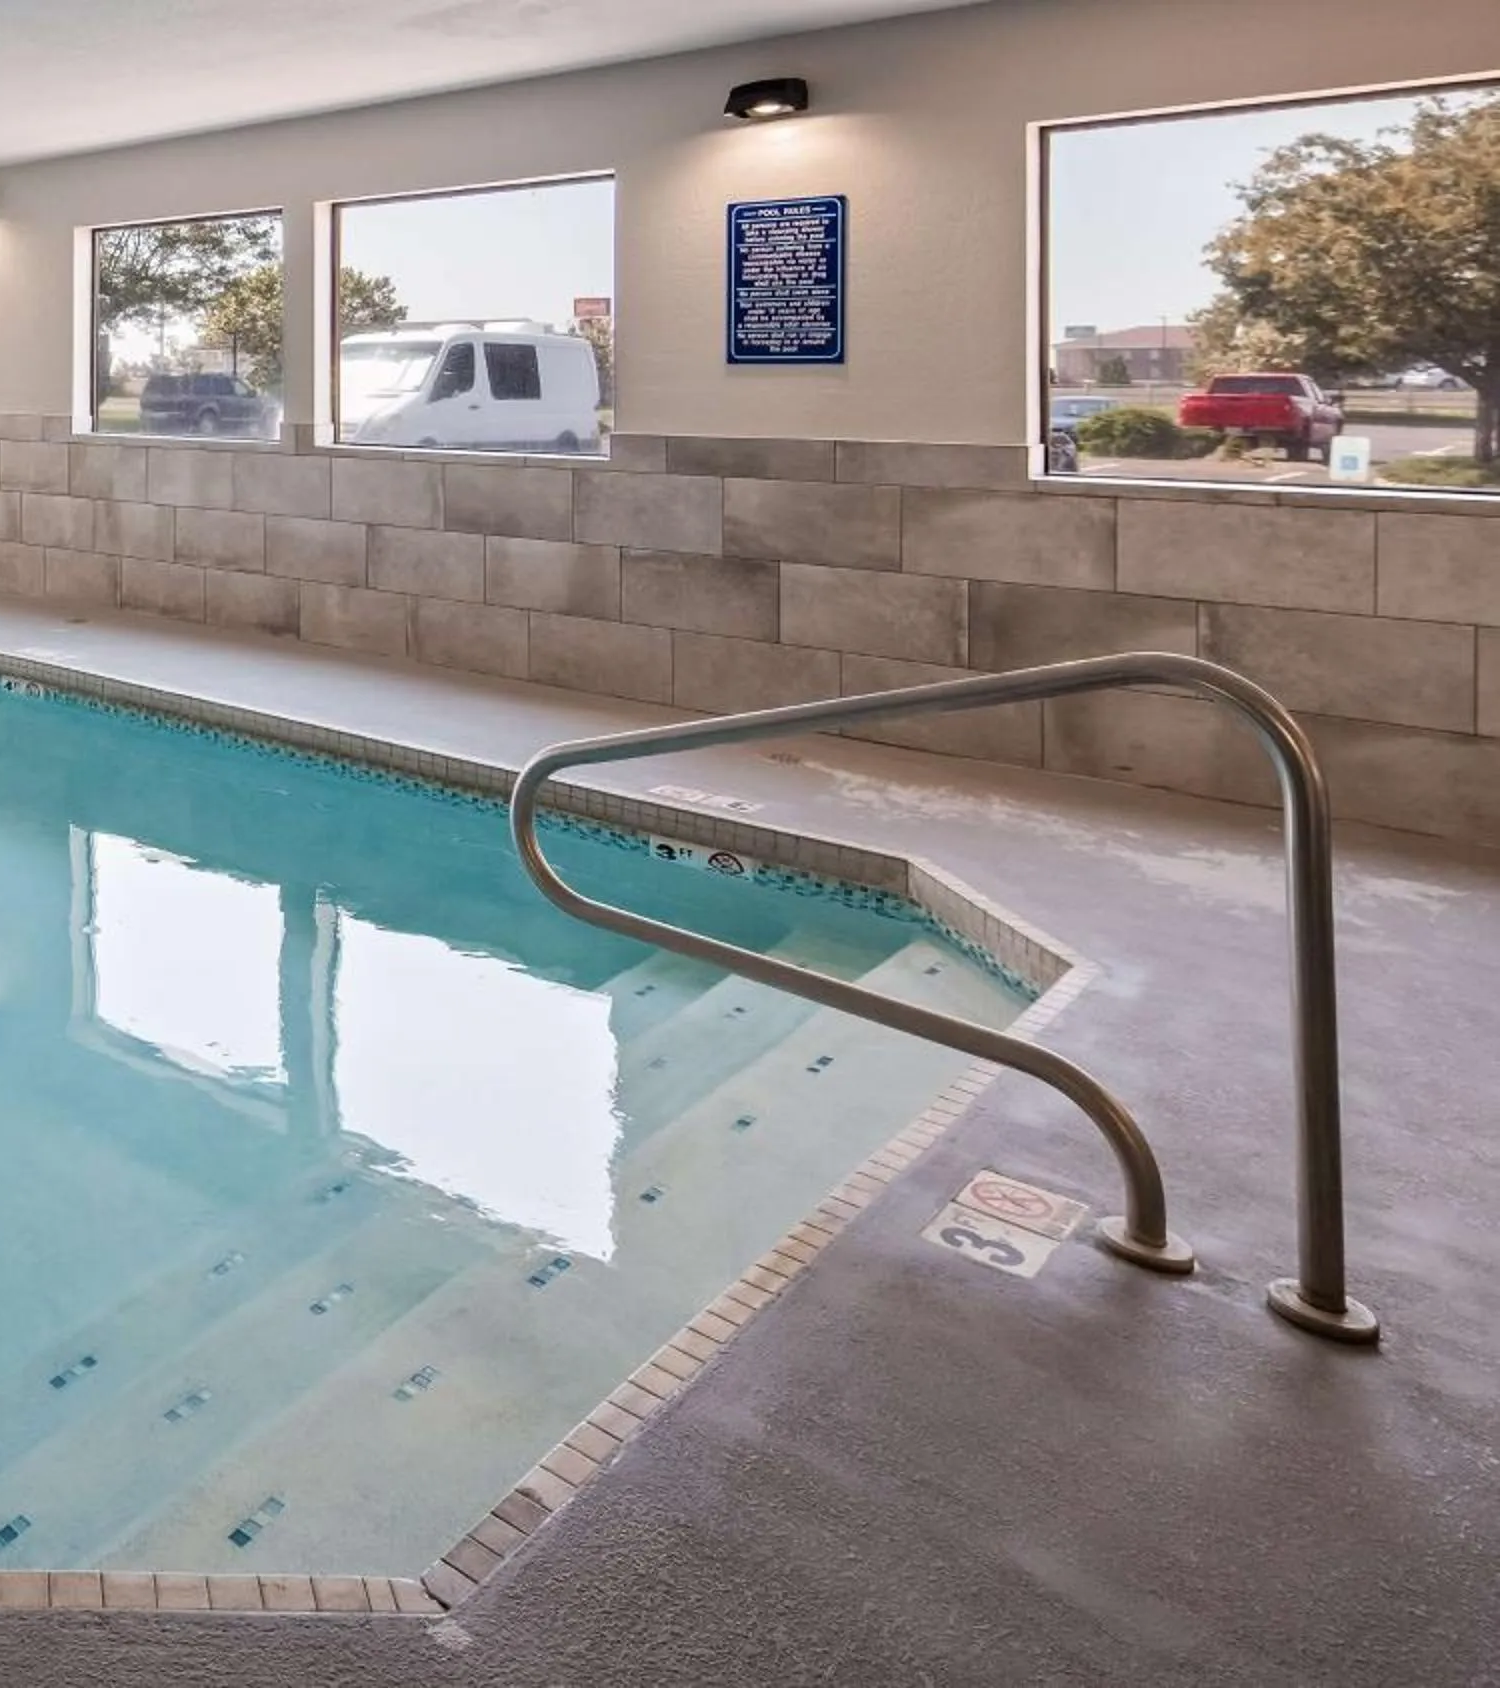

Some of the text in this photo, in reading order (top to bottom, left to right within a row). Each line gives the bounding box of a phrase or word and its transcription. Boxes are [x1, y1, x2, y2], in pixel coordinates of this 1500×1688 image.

[757, 205, 811, 217] POOL RULES
[655, 843, 677, 861] 3
[940, 1227, 1026, 1266] 3
